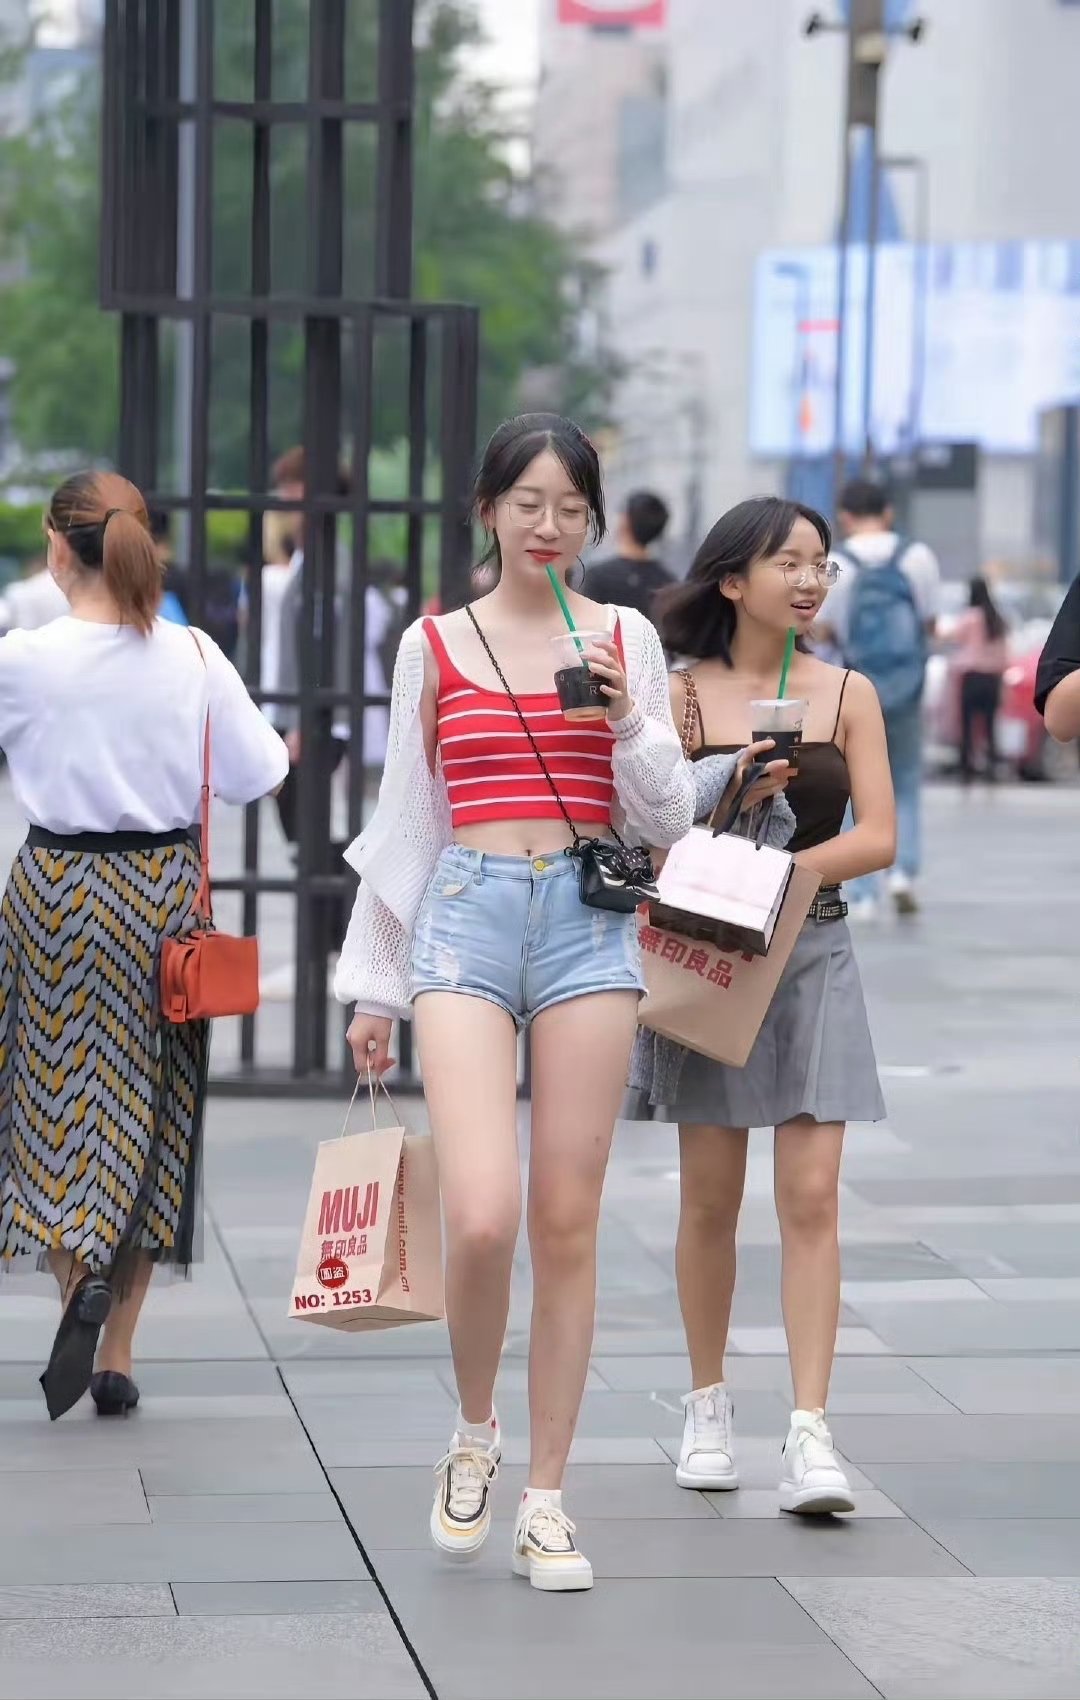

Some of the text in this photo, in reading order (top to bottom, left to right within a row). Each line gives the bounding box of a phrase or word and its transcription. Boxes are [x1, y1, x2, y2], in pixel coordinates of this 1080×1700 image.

[638, 925, 732, 989] 無印良品
[317, 1182, 380, 1235] MUJI
[320, 1234, 368, 1262] 無印良品
